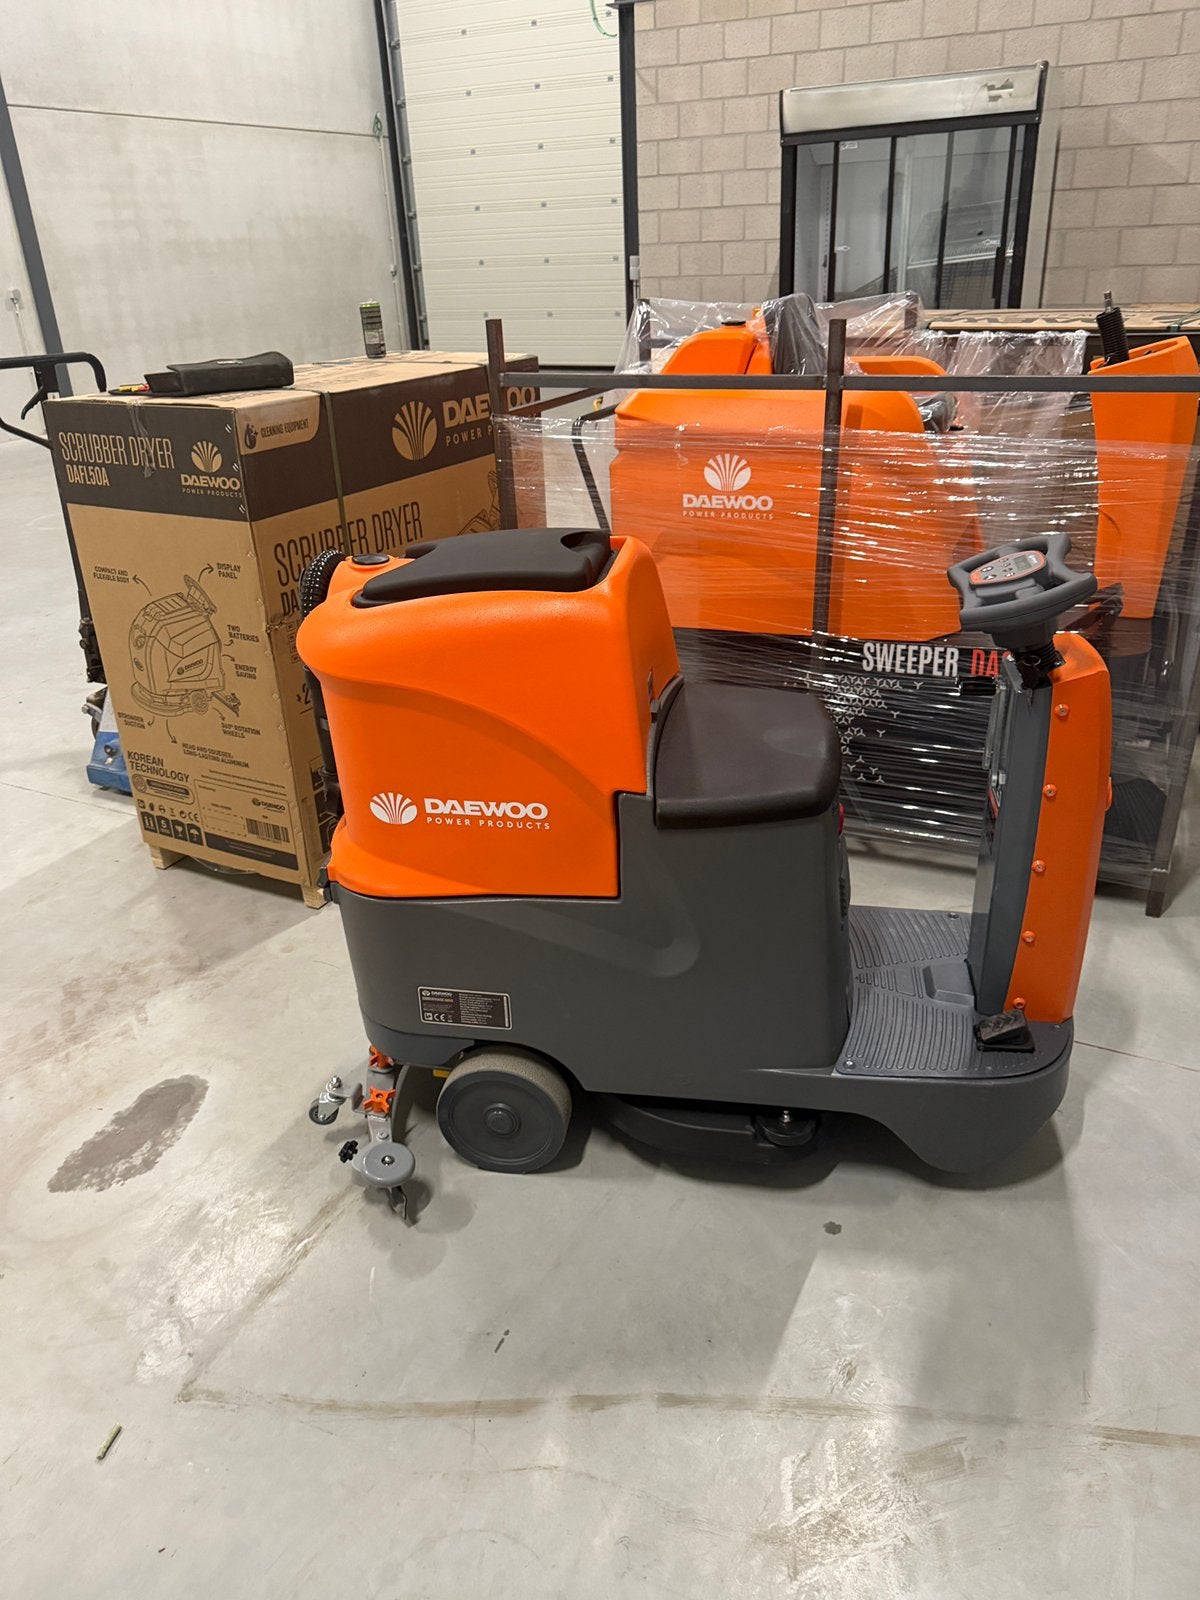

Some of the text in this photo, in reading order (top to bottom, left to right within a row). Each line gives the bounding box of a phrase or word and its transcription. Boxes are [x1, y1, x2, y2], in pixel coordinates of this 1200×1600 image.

[442, 386, 536, 429] DAEOO
[260, 418, 309, 438] CLEANING EQUIPMENT
[445, 427, 482, 447] POWER
[58, 431, 175, 469] SCRUBBER DRYER
[65, 464, 110, 487] DAFL50A
[180, 473, 241, 491] DAEWOO
[181, 488, 243, 499] POWER PRODUCTS
[682, 493, 774, 512] DAEWOO
[682, 510, 774, 520] POWER PRODUCTS
[371, 501, 424, 554] DRYER
[94, 565, 129, 577] COMPACT AND
[216, 562, 241, 573] DISPLAY
[93, 571, 129, 584] FLEXIBLE BODY
[218, 570, 239, 580] PANEL
[227, 624, 241, 633] TWO
[228, 631, 260, 643] BATTERIES
[862, 641, 960, 678] SWEEPER
[234, 663, 257, 674] ENERGY
[236, 671, 257, 680] SAVING
[124, 719, 146, 730] SUCTION
[235, 725, 261, 736] ROTATION
[222, 730, 245, 739] WHEELS
[127, 750, 164, 767] KOREAN
[129, 761, 190, 783] TECHNOLOGY
[423, 797, 549, 820] DAEWOO
[426, 816, 551, 830] POWER PRODUCTS
